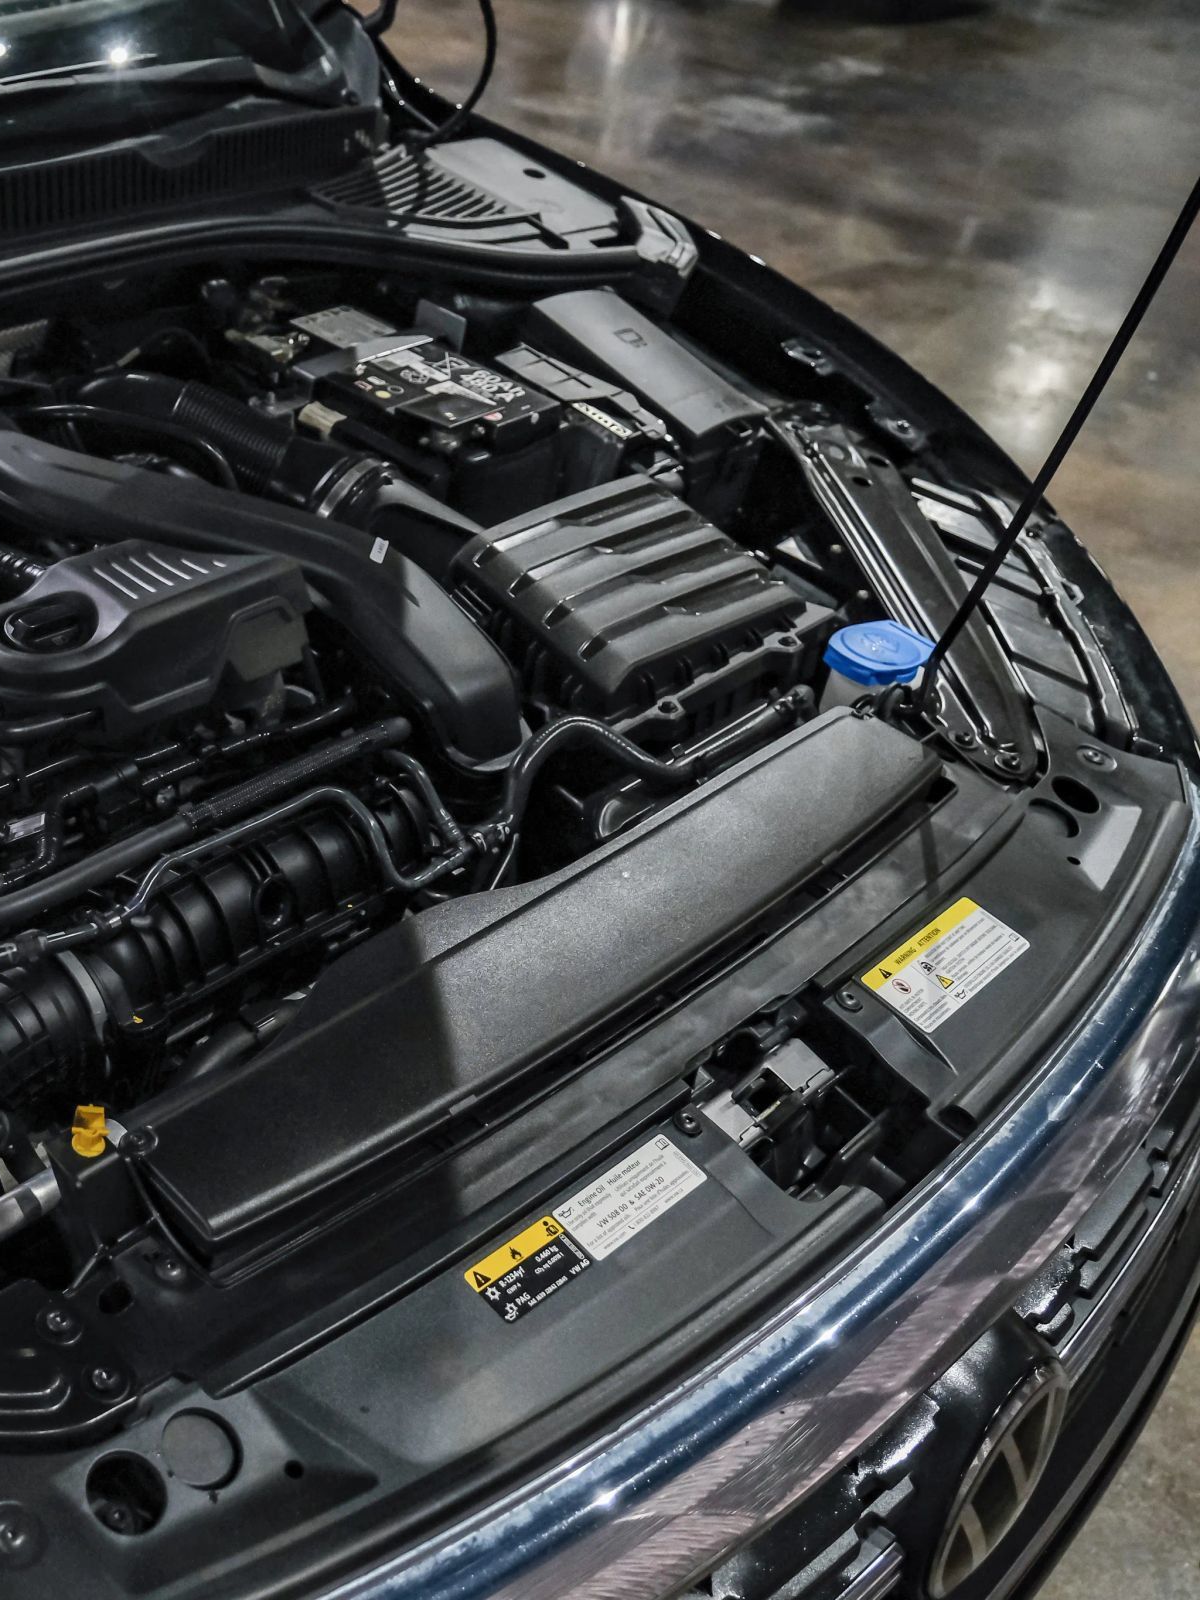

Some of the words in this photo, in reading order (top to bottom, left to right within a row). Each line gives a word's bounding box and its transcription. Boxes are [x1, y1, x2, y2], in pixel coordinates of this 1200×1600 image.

[473, 370, 525, 397] 60Ah
[917, 928, 941, 947] ATTENTION
[895, 947, 917, 965] WARNING
[606, 1173, 623, 1186] Huile
[621, 1160, 641, 1176] moteur
[577, 1192, 598, 1207] Engine
[595, 1184, 606, 1194] Oil
[596, 1217, 609, 1228] VW
[607, 1209, 621, 1220] 508
[618, 1203, 629, 1212] 00
[634, 1189, 647, 1201] SAE
[645, 1176, 665, 1192] 0W-20
[535, 1249, 551, 1262] 0.460
[548, 1245, 559, 1253] kg
[499, 1266, 525, 1287] R-1234yf
[569, 1264, 581, 1275] VW
[580, 1258, 590, 1268] AG
[515, 1292, 531, 1305] PAG
